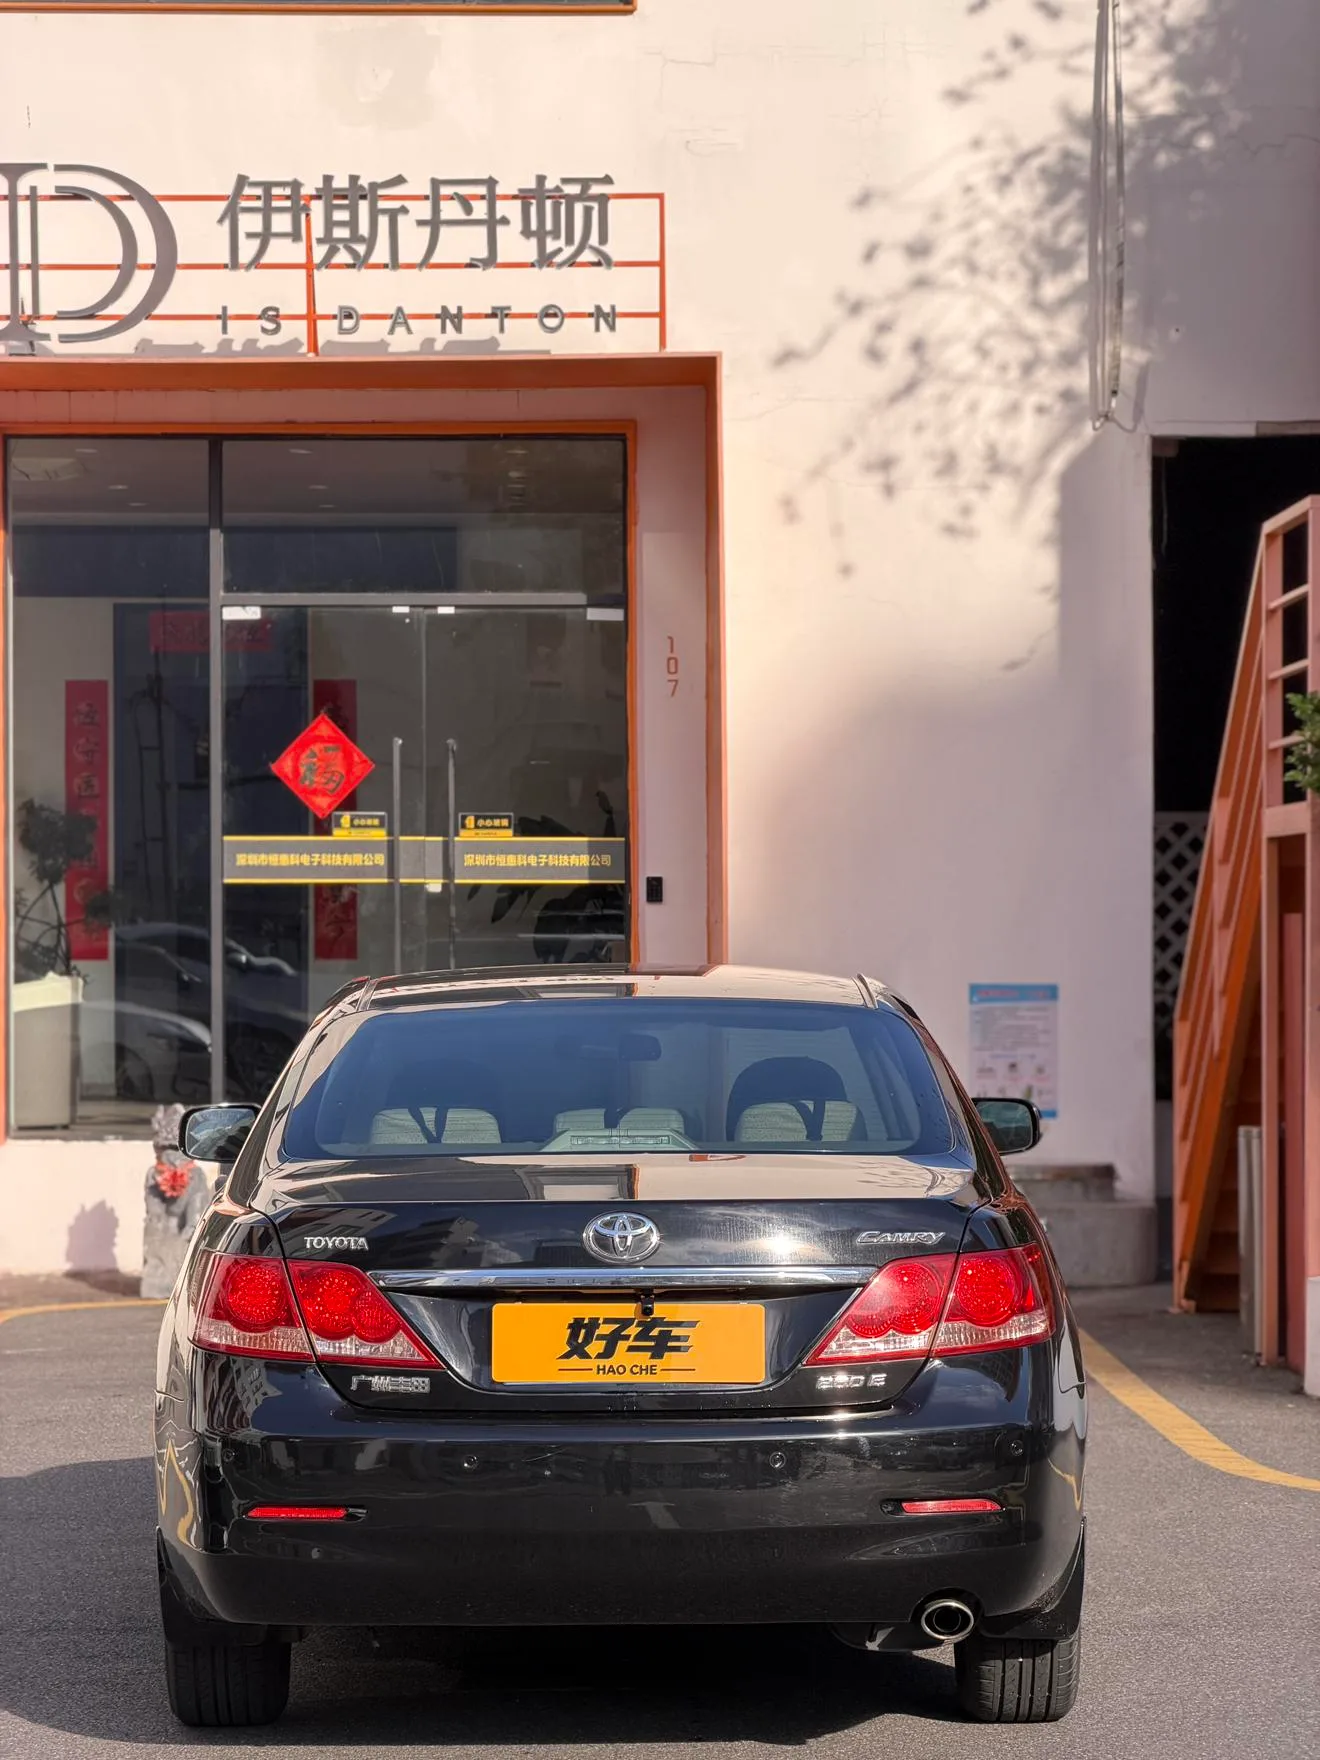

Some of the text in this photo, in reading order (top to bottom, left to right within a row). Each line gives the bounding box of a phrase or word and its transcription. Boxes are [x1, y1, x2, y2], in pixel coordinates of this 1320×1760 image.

[217, 173, 615, 271] 伊斯丹顿
[337, 303, 617, 335] DANTON
[667, 635, 679, 698] 107
[304, 1236, 369, 1250] TOYOTA
[857, 1230, 946, 1245] CAMRY
[556, 1316, 701, 1360] 好车
[596, 1364, 658, 1376] HAO CHE
[867, 1372, 888, 1387] E
